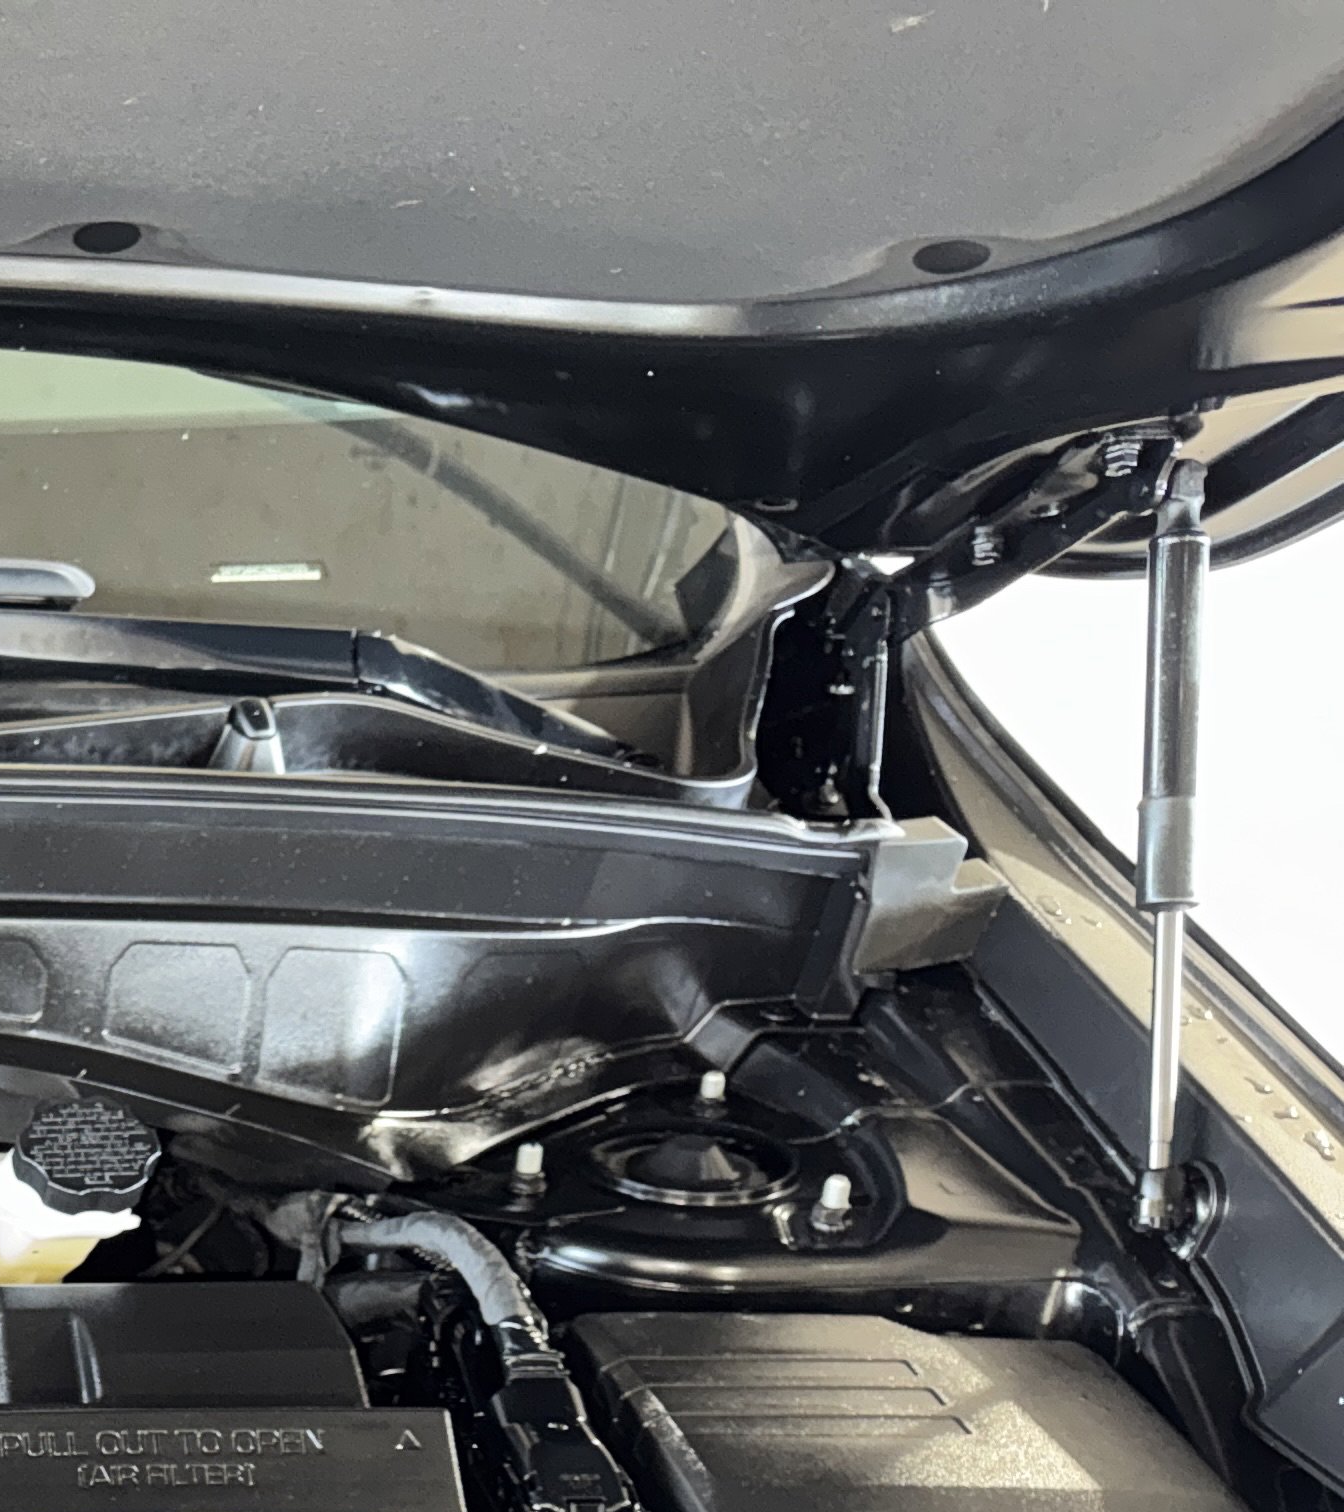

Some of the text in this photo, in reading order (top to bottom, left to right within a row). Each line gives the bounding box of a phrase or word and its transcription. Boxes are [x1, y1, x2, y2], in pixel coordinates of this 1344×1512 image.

[95, 1429, 168, 1455] OUT
[173, 1428, 222, 1455] TO
[231, 1428, 326, 1455] OPEN
